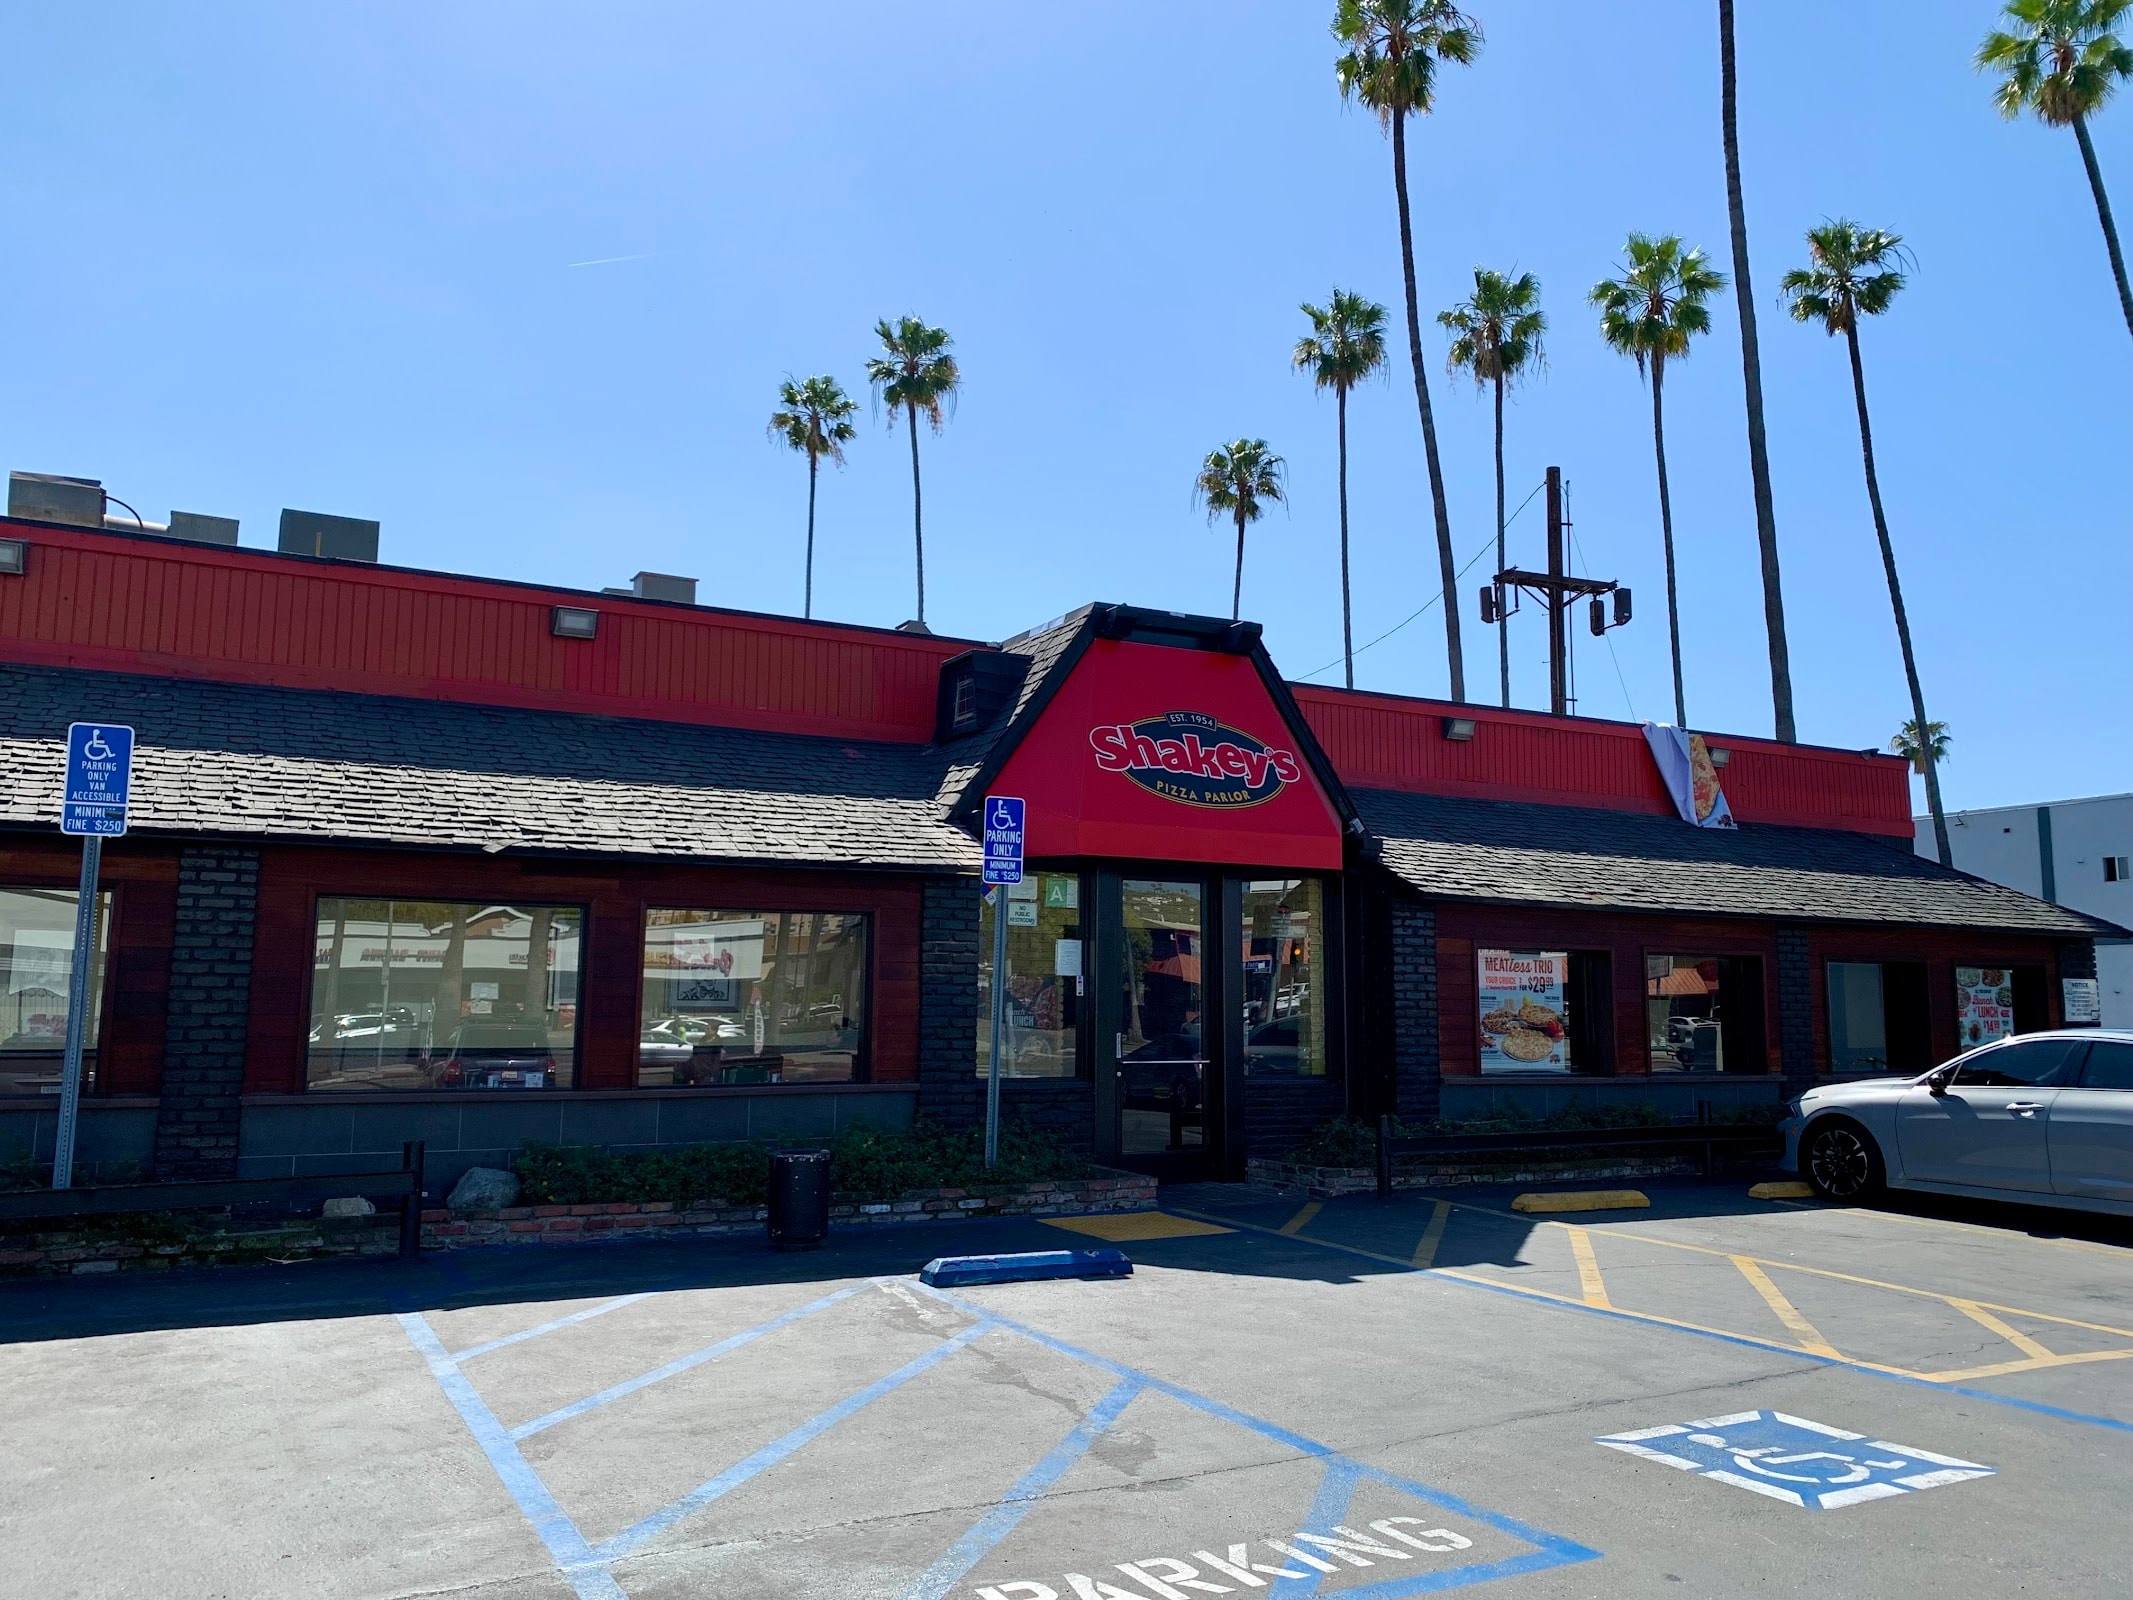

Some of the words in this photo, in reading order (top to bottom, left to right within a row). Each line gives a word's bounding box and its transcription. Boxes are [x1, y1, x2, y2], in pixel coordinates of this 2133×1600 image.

[1169, 713, 1188, 724] EST.
[1190, 714, 1214, 728] 1954
[1089, 725, 1301, 789] Shakey's
[81, 760, 117, 771] PARKING
[87, 771, 109, 781] ONLY
[89, 782, 106, 791] VAN
[1155, 780, 1198, 801] PIZZA
[1204, 789, 1251, 804] PARLOR
[72, 791, 121, 802] ACCESSIBLE
[66, 819, 87, 830] FINE
[95, 820, 121, 832] $250
[986, 829, 1022, 844] PARKING
[993, 843, 1014, 857] ONLY
[989, 860, 1016, 870] MINIMUM
[985, 871, 999, 880] FINE
[1003, 871, 1020, 881] $250
[1050, 886, 1064, 902] A
[1009, 916, 1035, 925] RESTROOMS
[1485, 957, 1533, 974] MEATless
[1533, 959, 1553, 974] TRIO
[1485, 976, 1498, 984] YOUR
[1498, 976, 1517, 985] CHOICE
[1977, 1006, 1999, 1018] LUNCH
[1009, 1015, 1034, 1027] LUNCH
[974, 1516, 1473, 1600] PARKING
